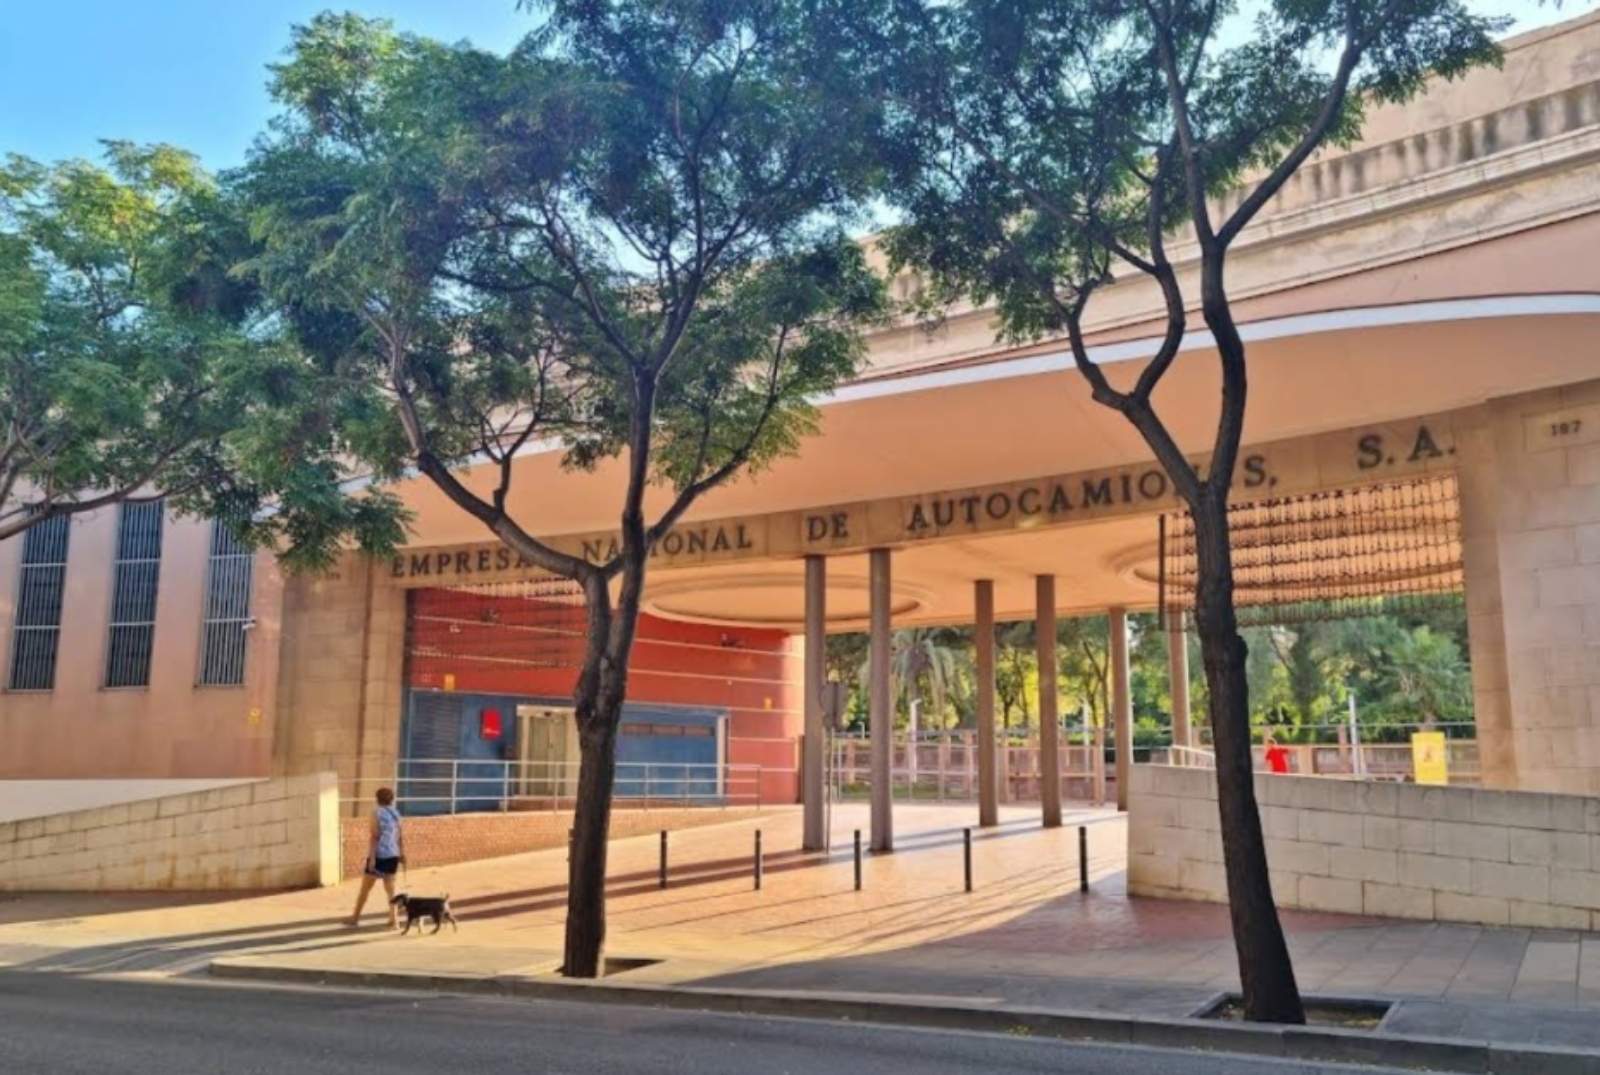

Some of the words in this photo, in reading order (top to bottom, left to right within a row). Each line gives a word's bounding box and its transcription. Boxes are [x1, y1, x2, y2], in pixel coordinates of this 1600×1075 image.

[581, 525, 752, 560] NAIONAL
[808, 512, 849, 542] DE
[907, 455, 1278, 531] AUTOCAMIOS,
